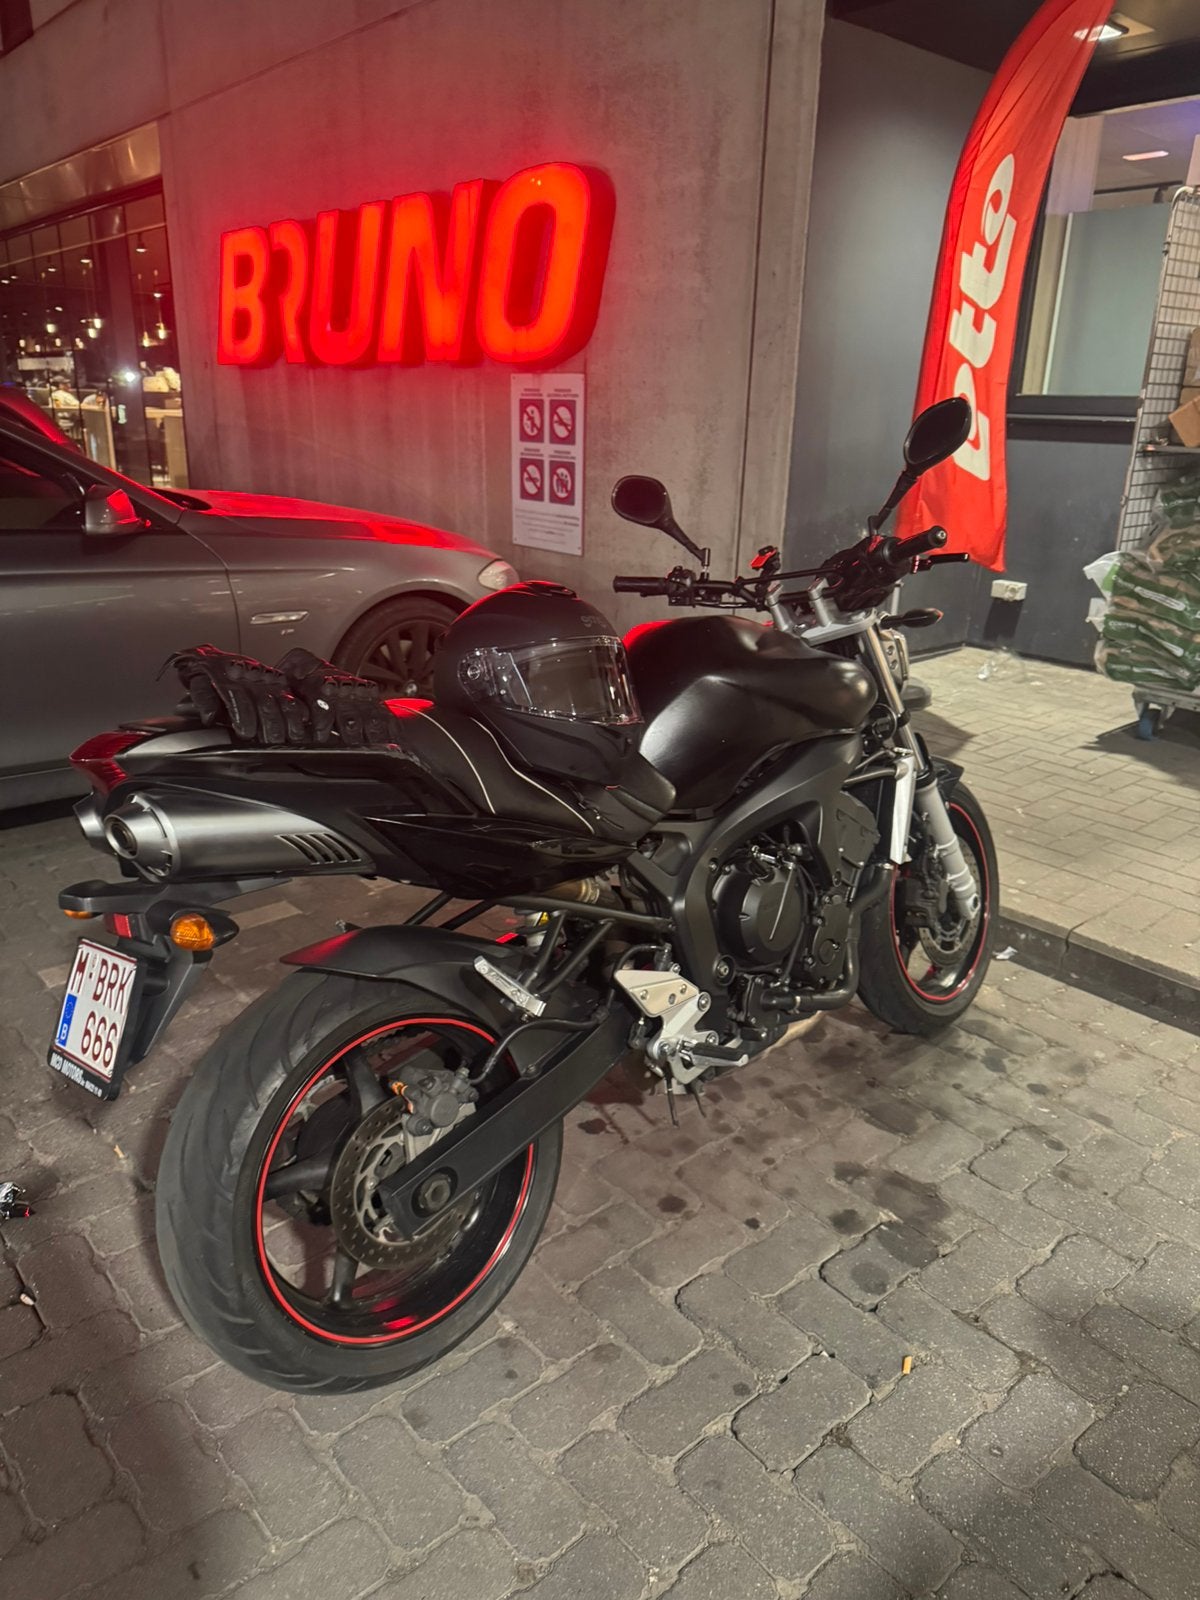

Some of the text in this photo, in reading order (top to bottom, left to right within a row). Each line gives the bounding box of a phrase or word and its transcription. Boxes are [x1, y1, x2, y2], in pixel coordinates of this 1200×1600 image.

[218, 162, 614, 368] BRUNO
[60, 1023, 69, 1041] B
[81, 1010, 118, 1068] 666
